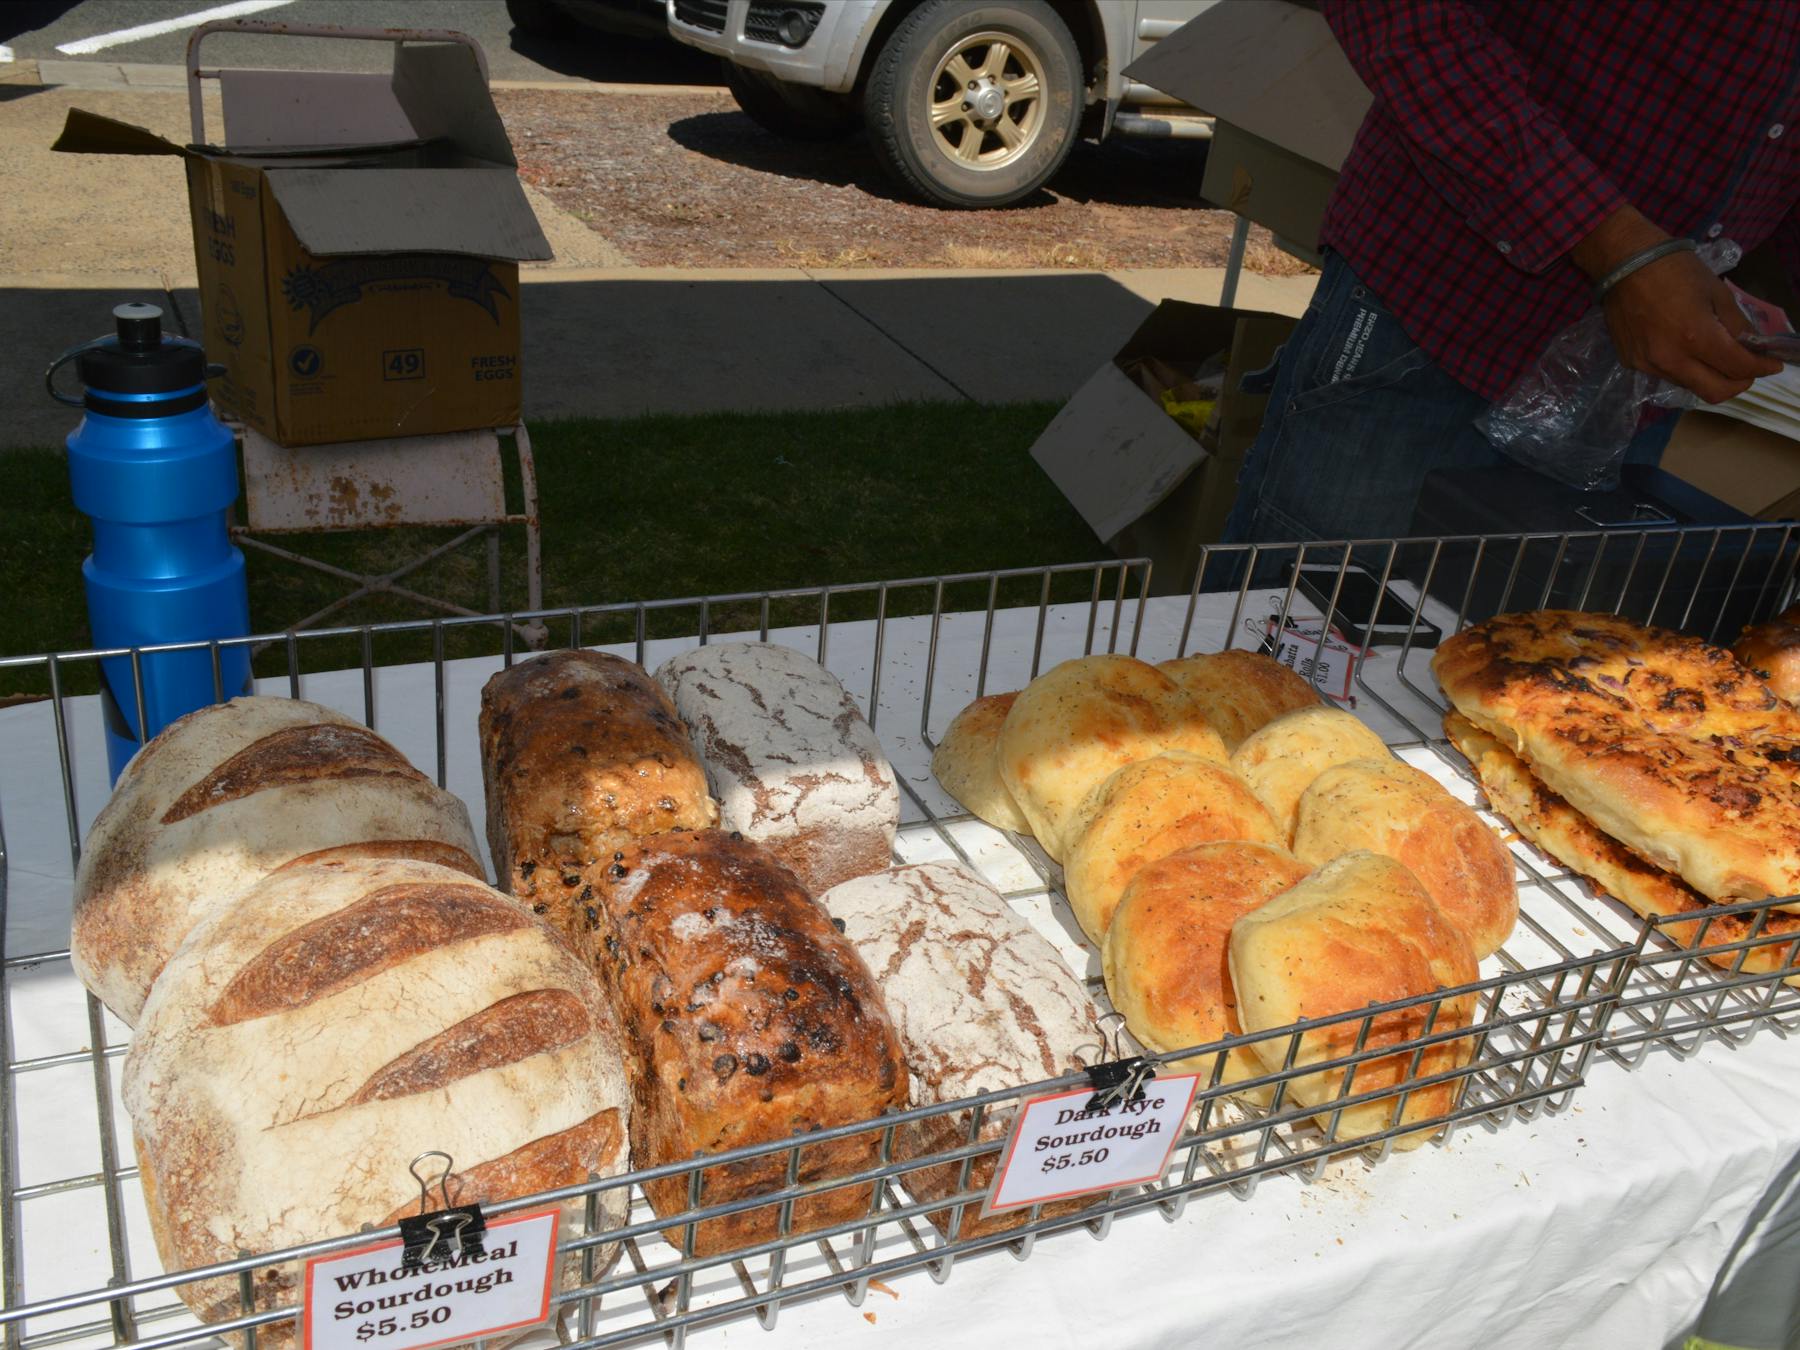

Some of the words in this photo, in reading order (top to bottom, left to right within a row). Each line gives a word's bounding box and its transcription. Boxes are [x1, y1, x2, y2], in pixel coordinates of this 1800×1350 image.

[1343, 307, 1368, 354] PREMIUM
[1361, 311, 1378, 341] ENZO
[388, 353, 420, 375] 49
[471, 354, 517, 369] FRESH
[1346, 339, 1366, 373] JEANS
[474, 367, 515, 382] EGGS
[1284, 643, 1300, 669] abatta
[1119, 1096, 1166, 1116] Rye
[1034, 1117, 1161, 1152] Sourdough
[1041, 1147, 1110, 1174] $5.50
[334, 1268, 514, 1321] Sourdough
[355, 1306, 453, 1343] $5.50
